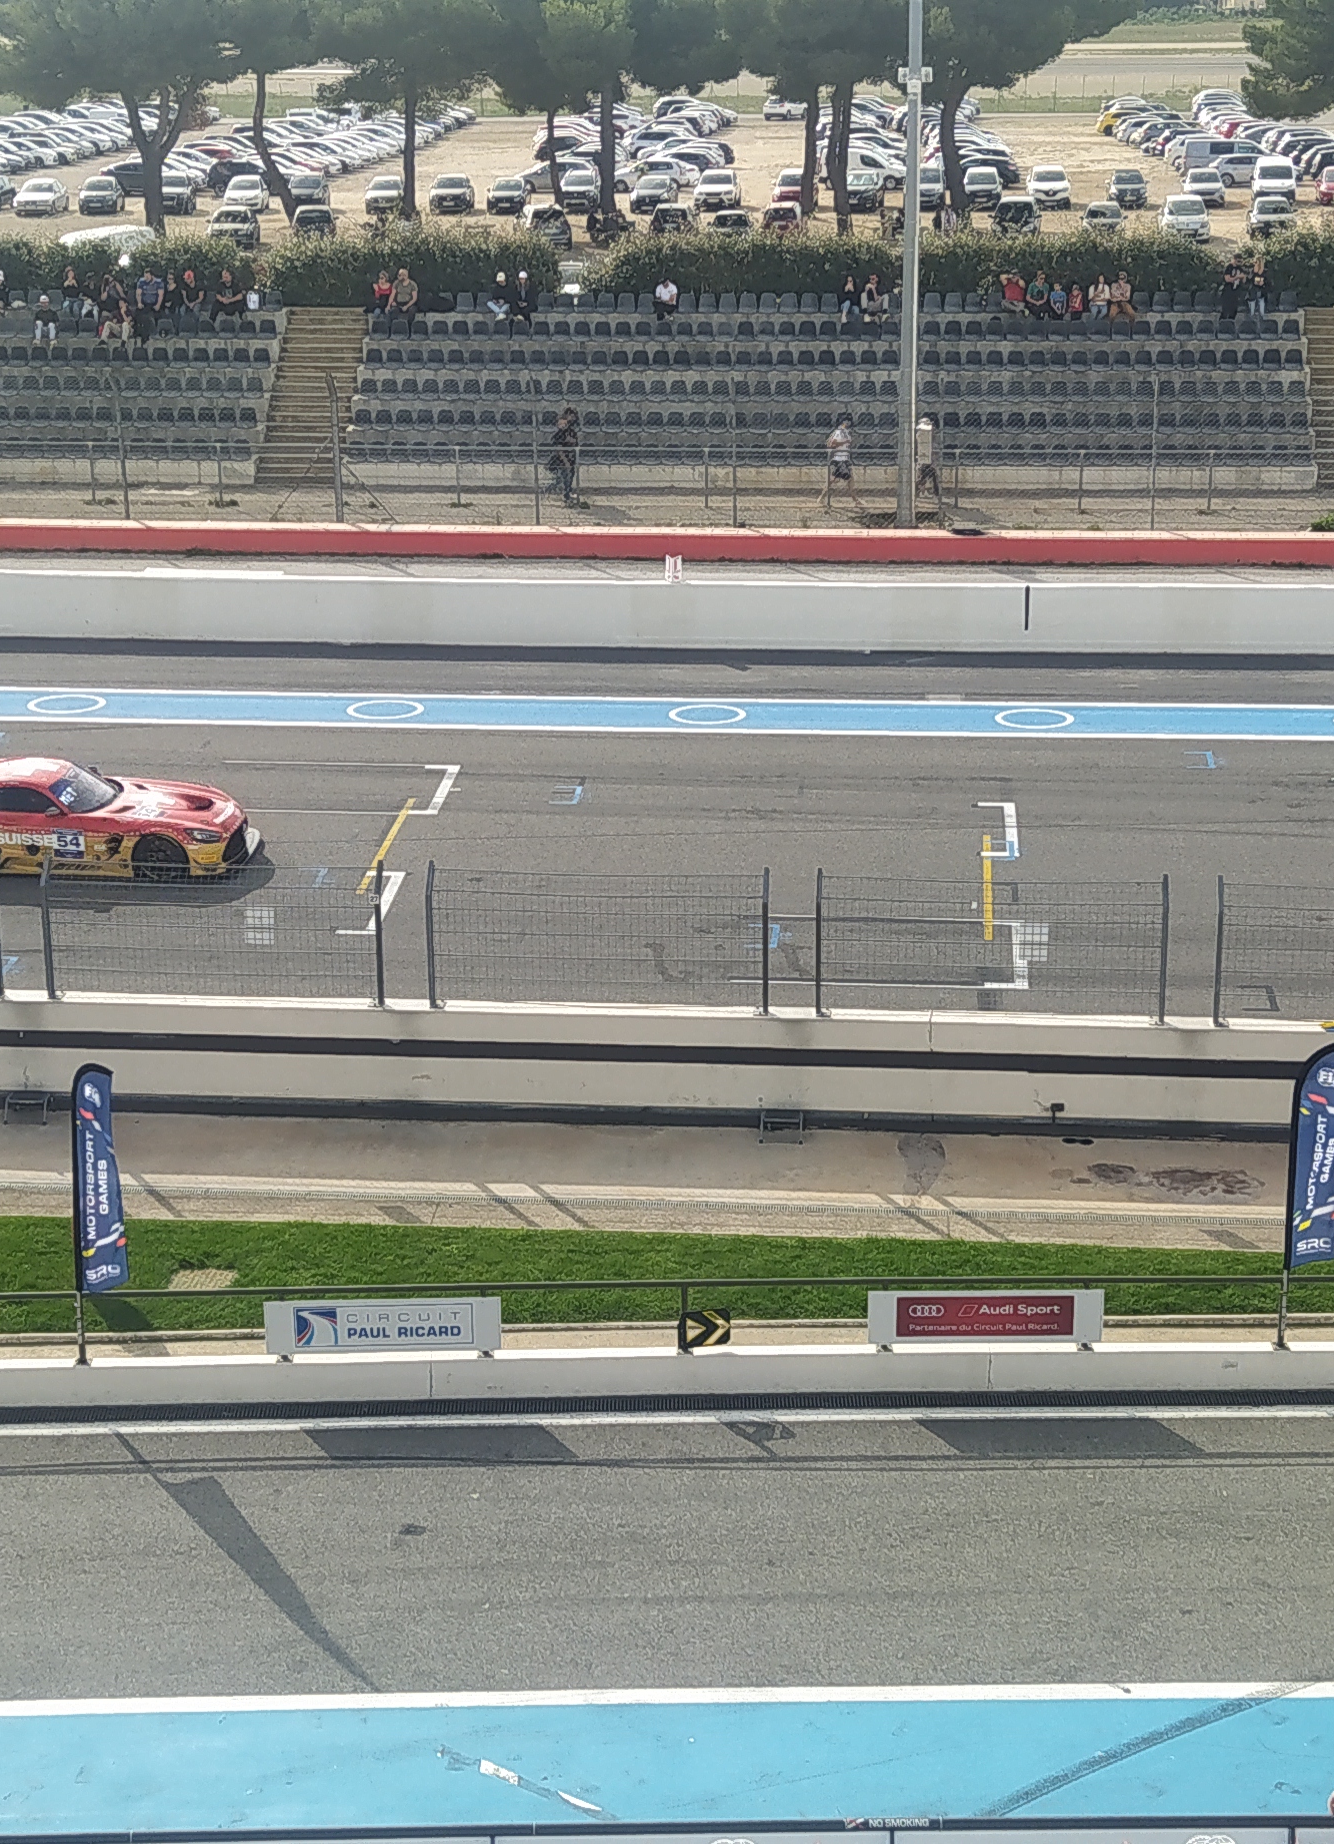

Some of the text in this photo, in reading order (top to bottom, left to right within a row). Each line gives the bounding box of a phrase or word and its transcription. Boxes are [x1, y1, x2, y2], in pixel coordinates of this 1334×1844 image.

[57, 835, 81, 849] 54
[85, 1130, 97, 1239] MOTORSPORT
[97, 1159, 109, 1215] GAMES
[979, 1304, 1061, 1316] Audi Sport
[346, 1311, 462, 1324] CIRCUIT
[347, 1325, 461, 1339] PAUL RICARD
[868, 1818, 930, 1828] NO SMOKING
